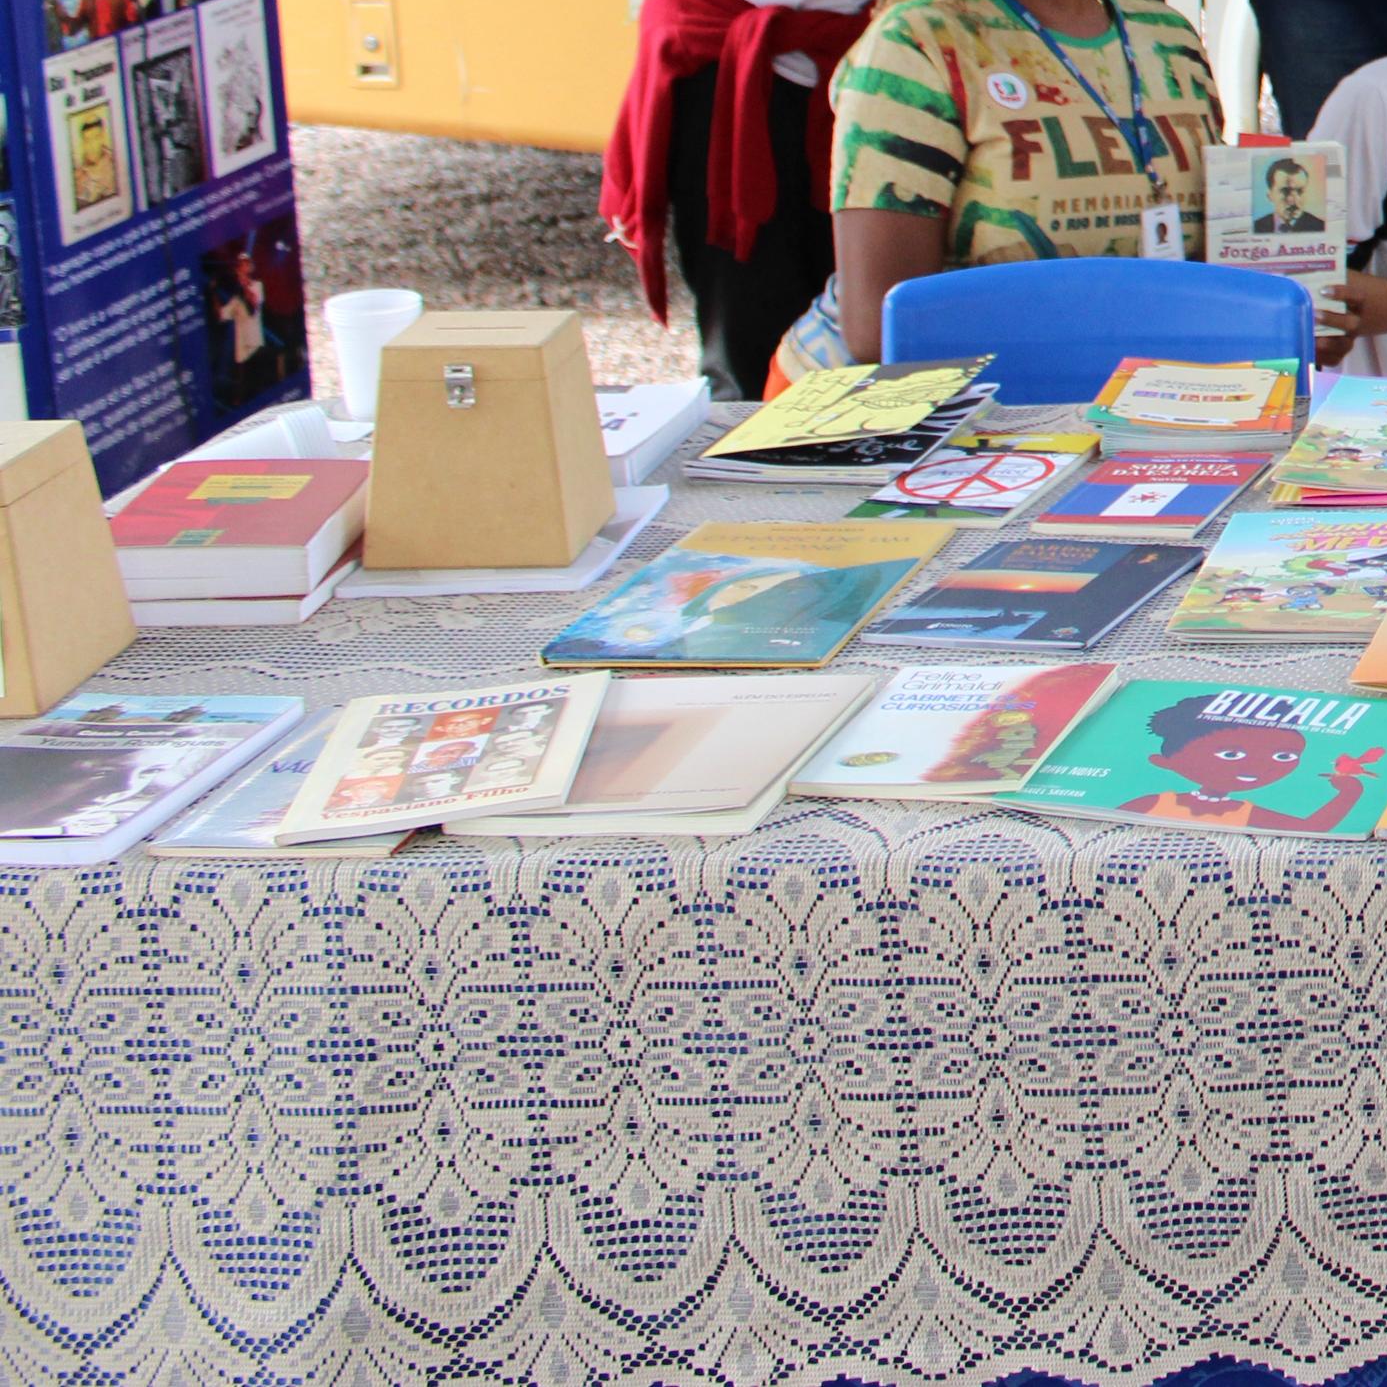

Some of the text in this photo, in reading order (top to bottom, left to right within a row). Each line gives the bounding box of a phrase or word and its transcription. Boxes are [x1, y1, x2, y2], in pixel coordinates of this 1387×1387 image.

[1219, 243, 1338, 261] Jorge Amado
[910, 670, 982, 683] Felipe
[902, 680, 1003, 691] Grimaldi
[377, 684, 572, 715] RECORDOS
[889, 693, 991, 702] GABINETE
[1204, 689, 1371, 731] BUCALA
[39, 736, 228, 749] Yumara Rodrigues
[320, 784, 530, 821] Vespasiano Filho
